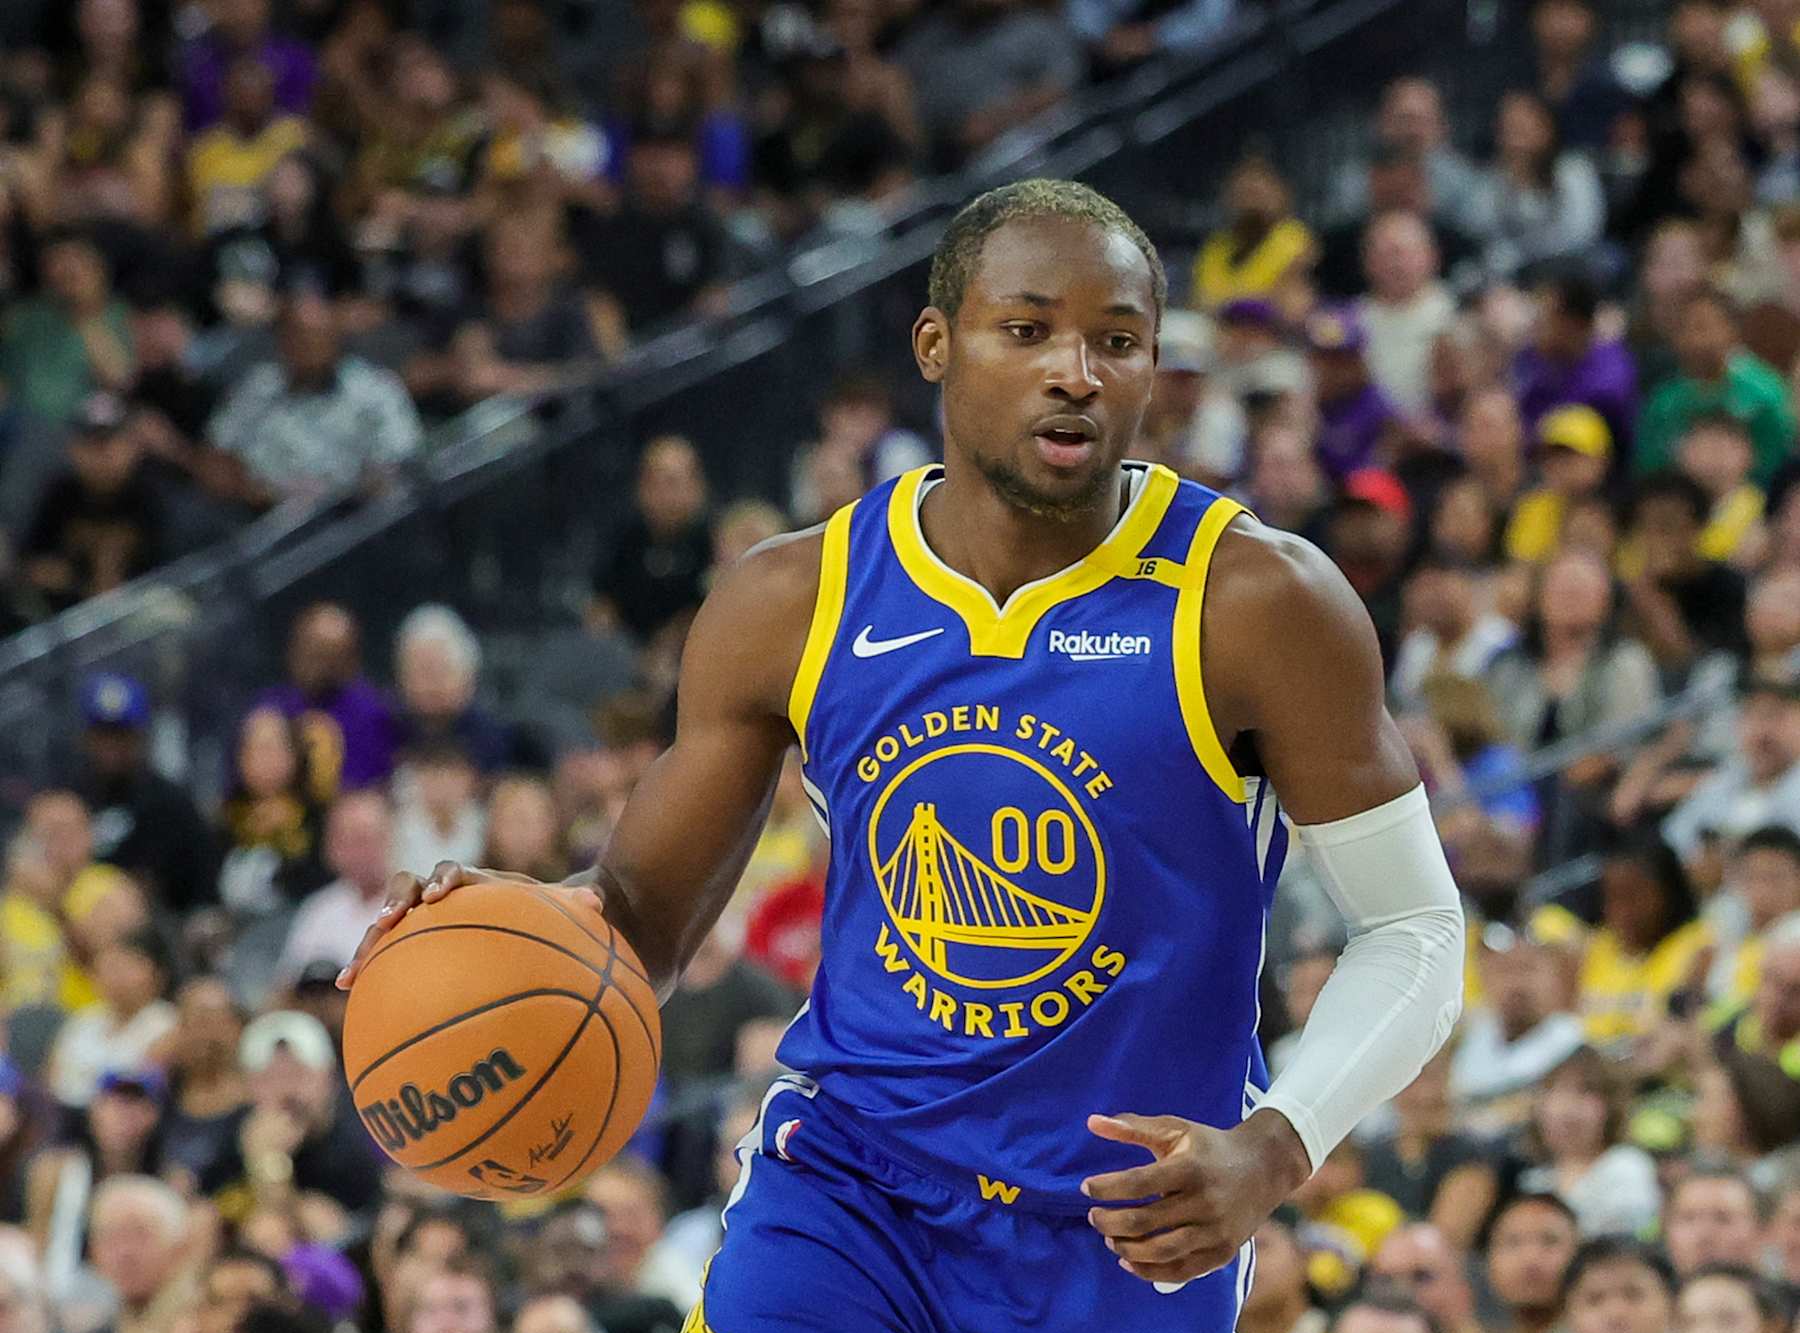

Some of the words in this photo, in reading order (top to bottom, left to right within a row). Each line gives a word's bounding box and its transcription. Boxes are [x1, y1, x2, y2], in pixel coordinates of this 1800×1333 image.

[1135, 560, 1158, 577] 16
[1049, 629, 1151, 656] Rakuten
[856, 703, 1000, 783] GOLDEN
[1015, 713, 1114, 800] STATE
[990, 805, 1077, 876] 00
[873, 920, 1127, 1039] WARRIORS
[361, 1047, 528, 1152] Wilson
